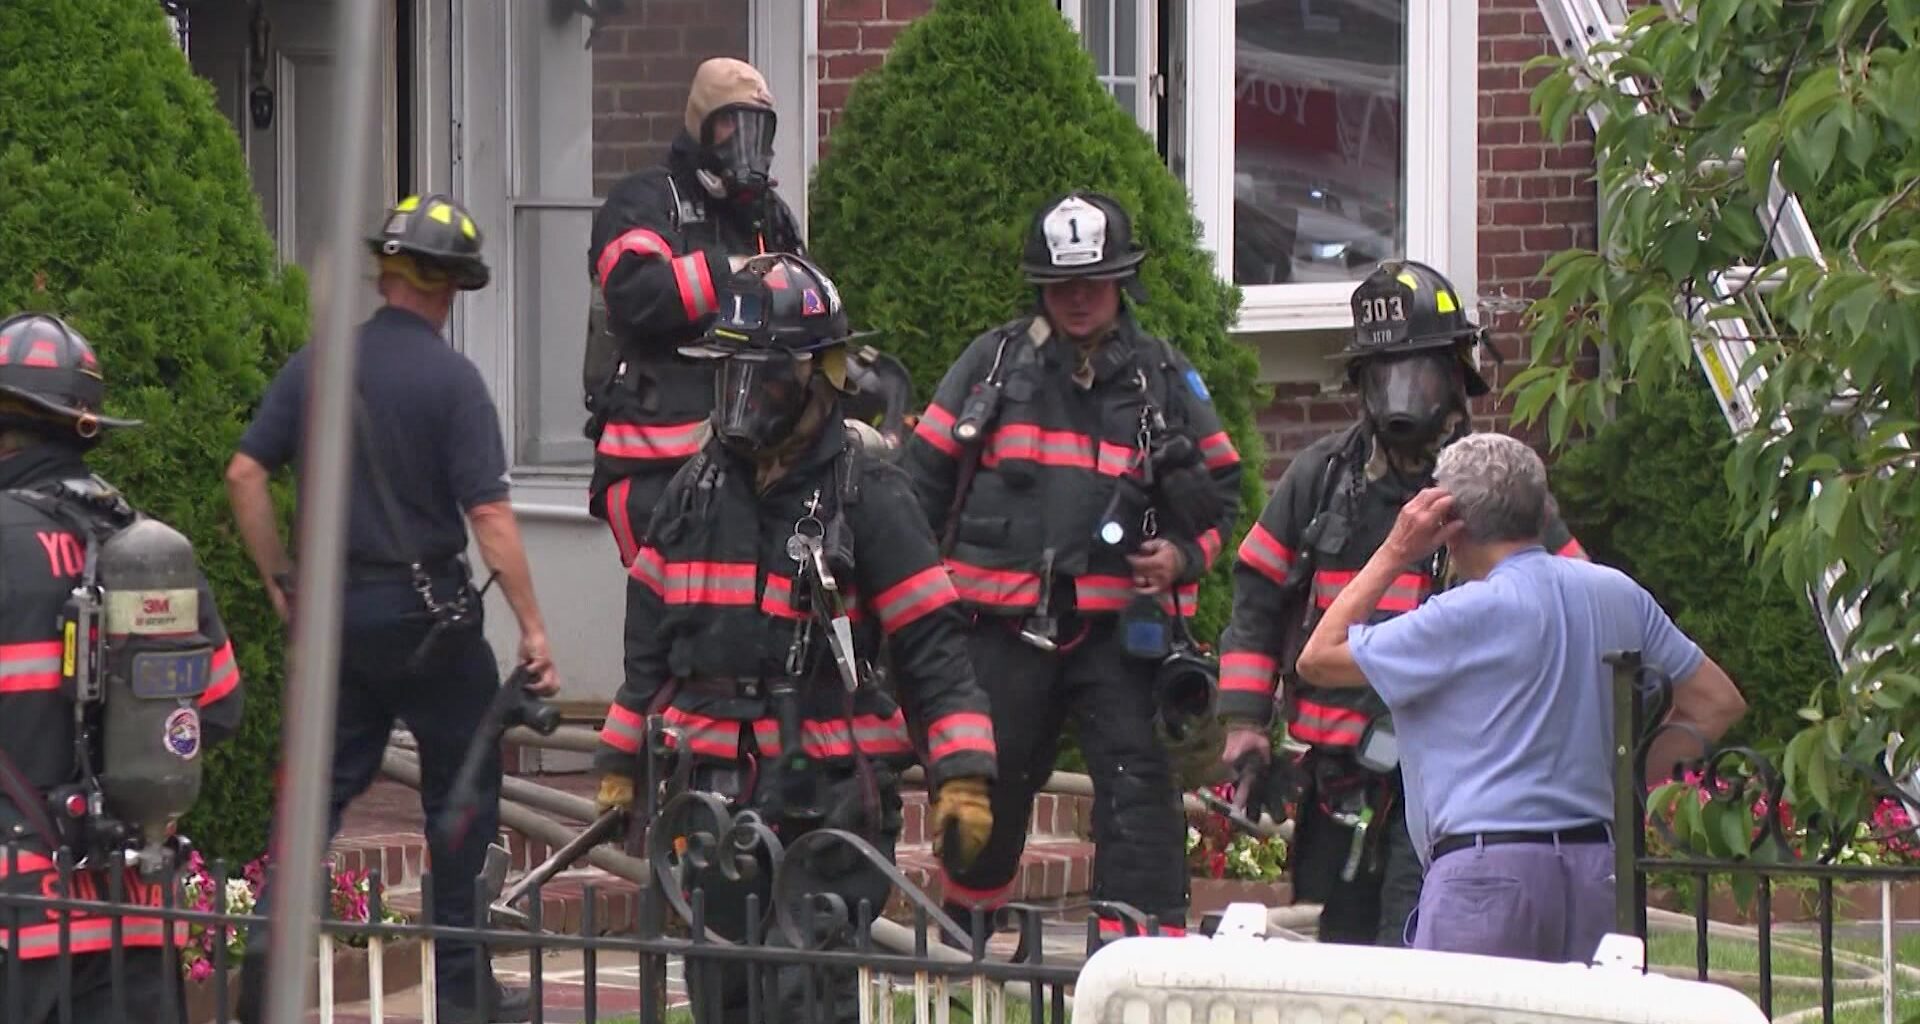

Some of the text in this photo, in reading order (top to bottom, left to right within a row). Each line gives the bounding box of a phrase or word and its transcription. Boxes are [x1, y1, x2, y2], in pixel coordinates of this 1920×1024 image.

[1068, 218, 1081, 243] 1
[731, 294, 745, 326] 1
[1361, 296, 1405, 323] 303
[143, 599, 170, 613] 3M
